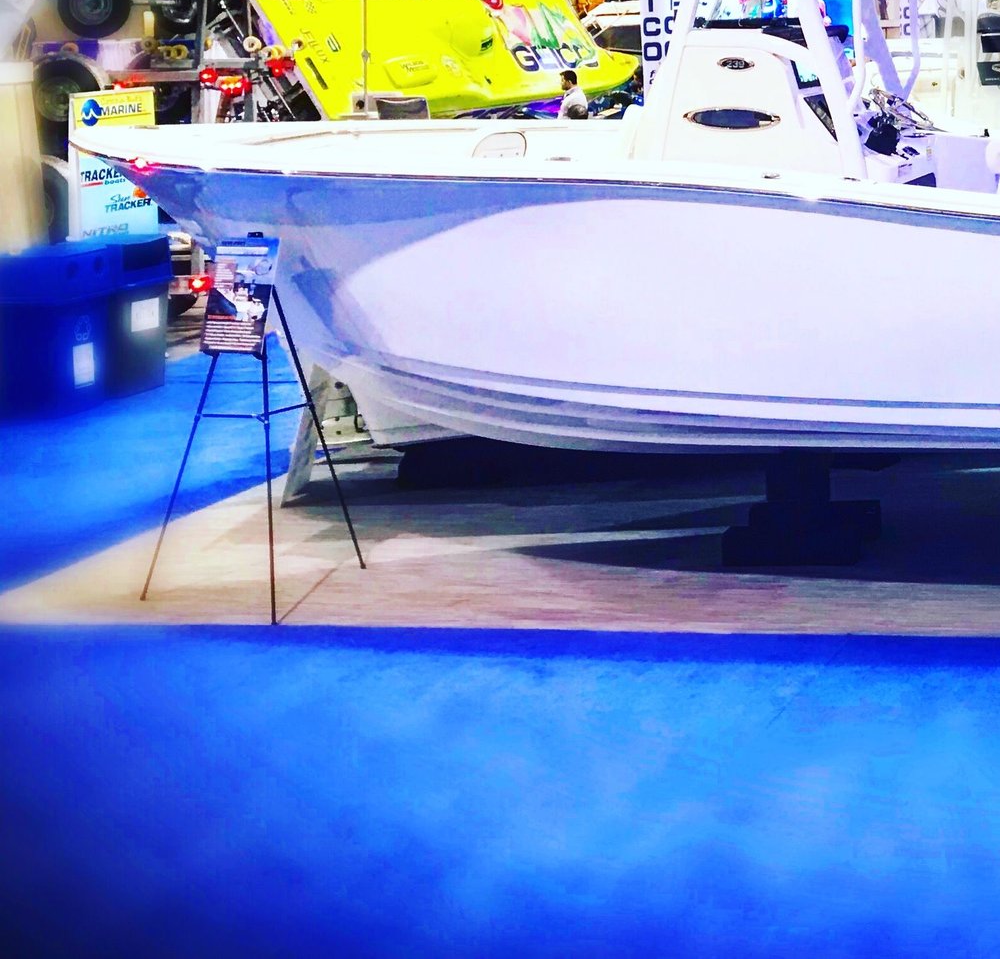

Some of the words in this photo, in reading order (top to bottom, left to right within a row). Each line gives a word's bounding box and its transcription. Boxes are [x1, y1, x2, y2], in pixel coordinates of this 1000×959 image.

[101, 103, 143, 116] MARINE
[80, 167, 124, 183] TRACKE
[105, 198, 152, 214] TRACKER
[82, 222, 129, 237] NITRO
